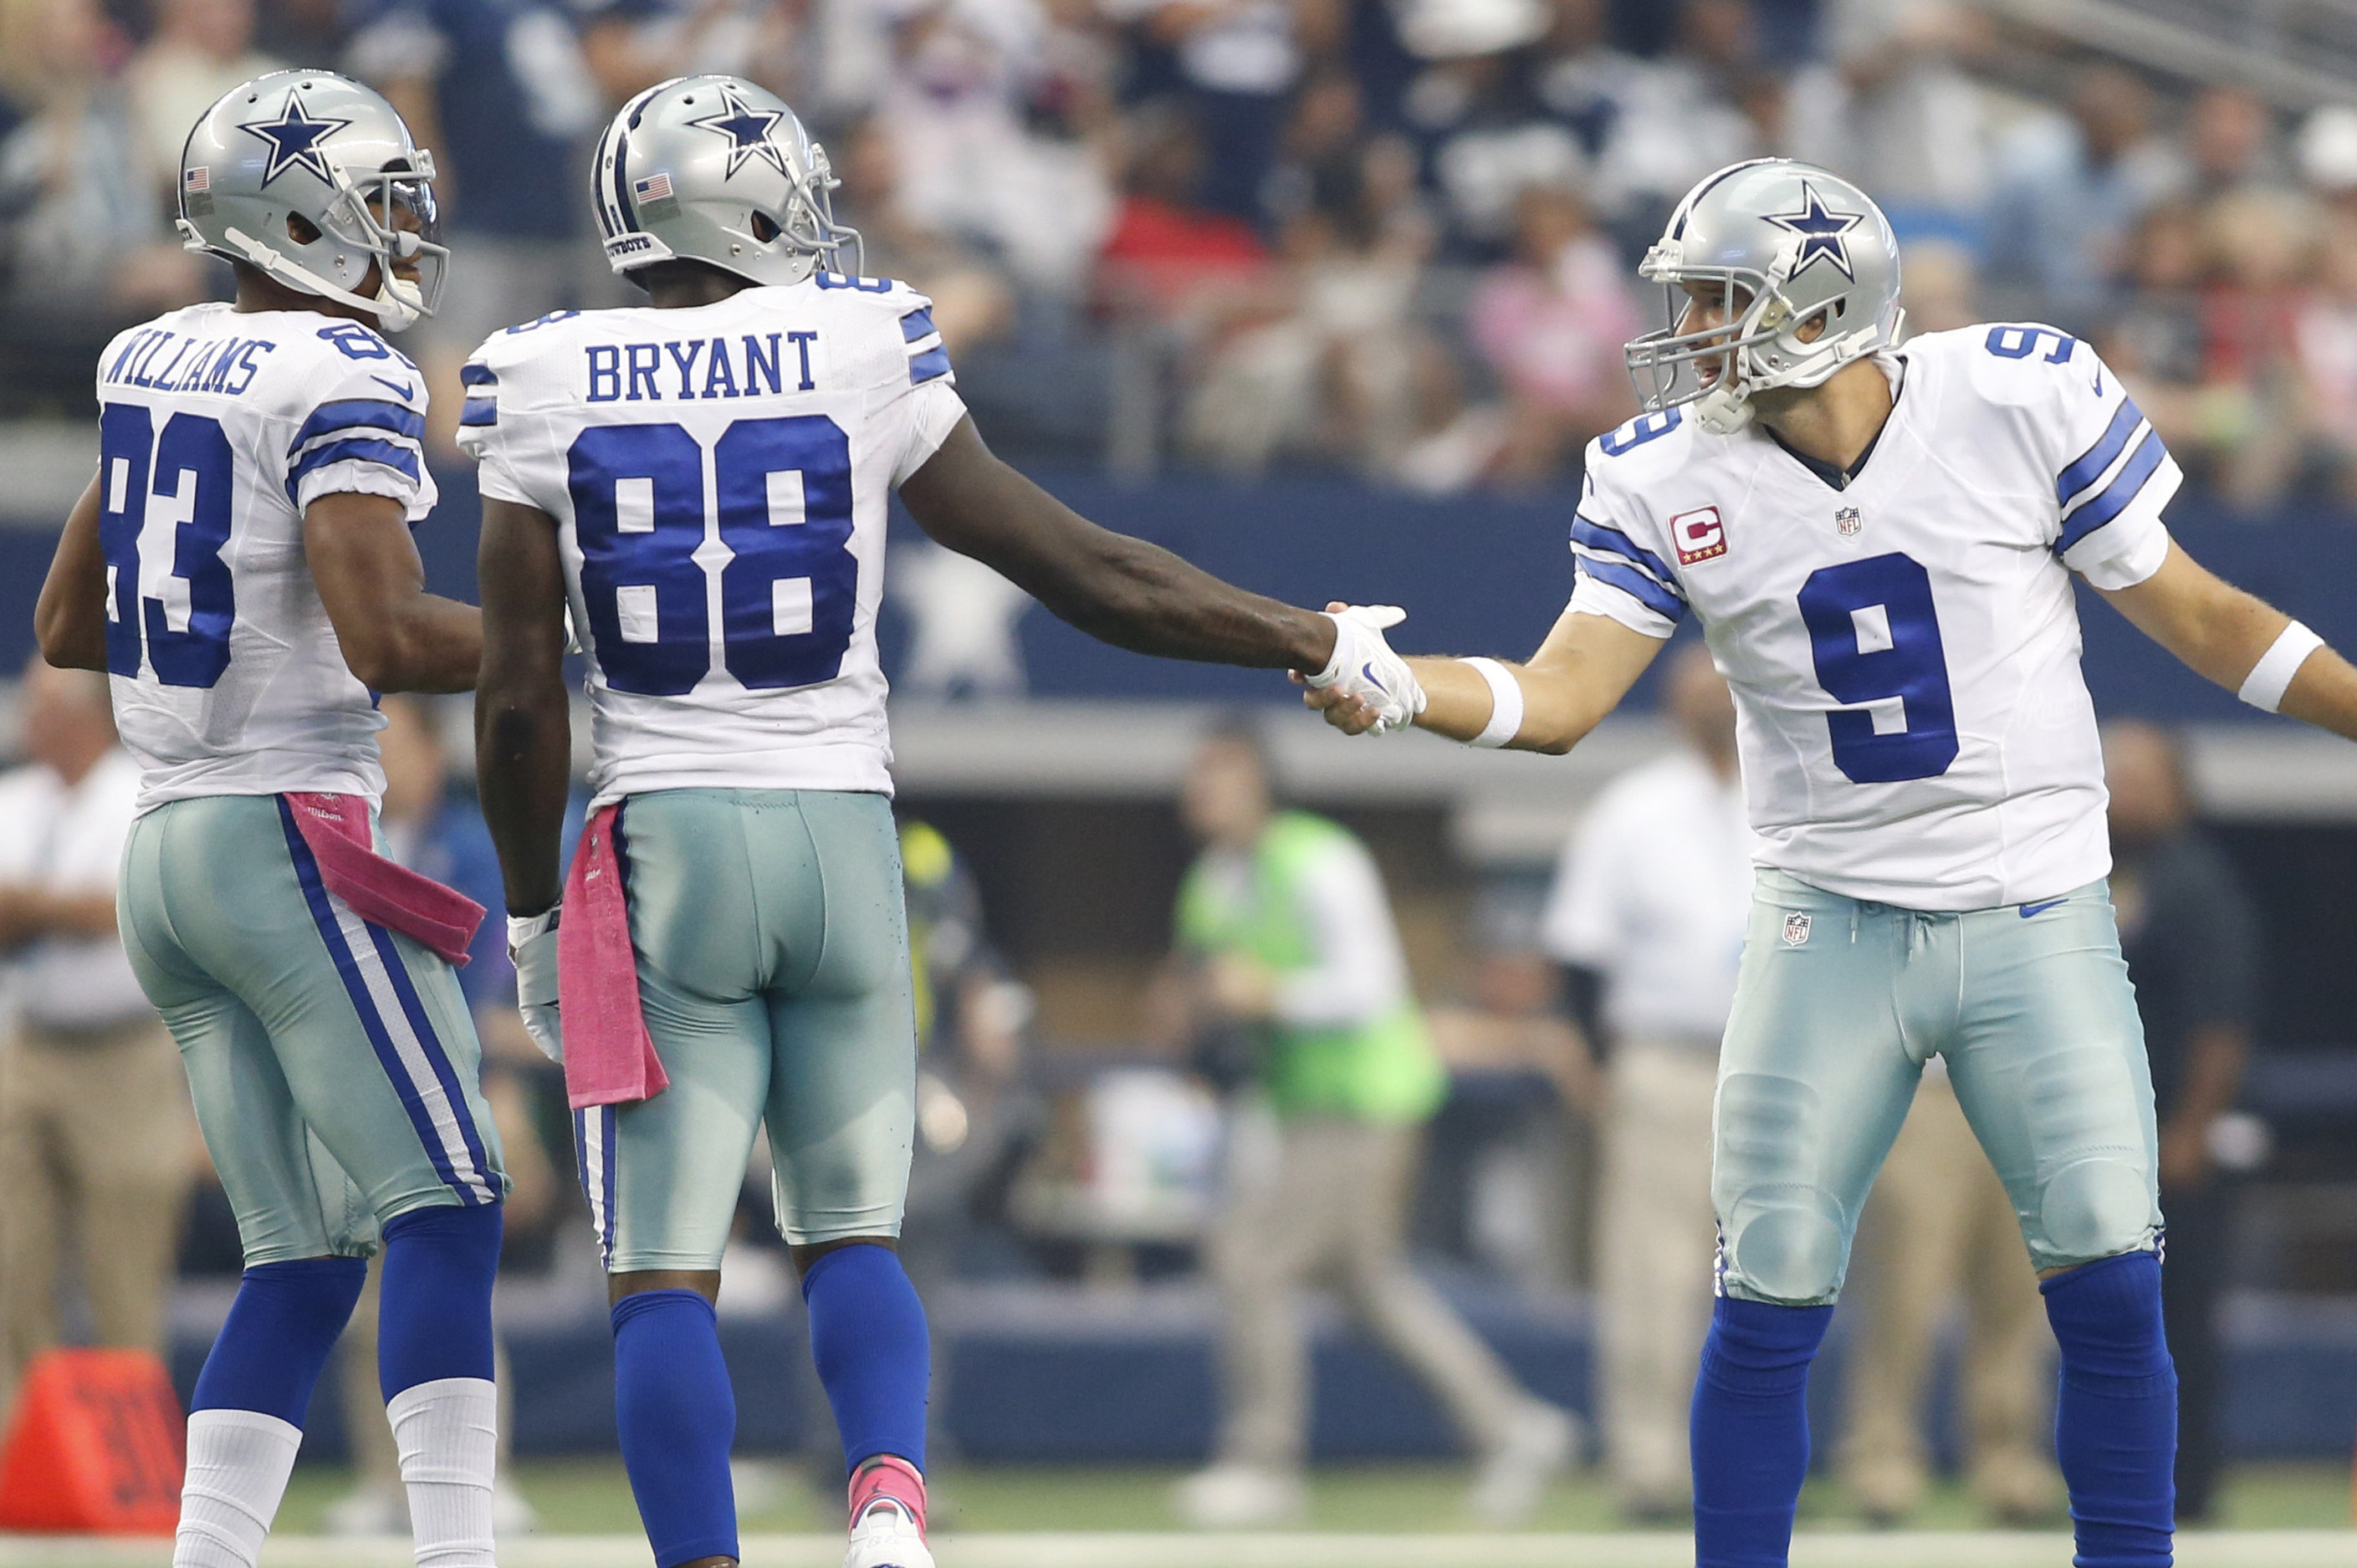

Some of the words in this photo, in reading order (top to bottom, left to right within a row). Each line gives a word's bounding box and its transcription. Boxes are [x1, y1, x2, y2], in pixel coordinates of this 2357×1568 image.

[585, 331, 818, 402] BRYANT
[1985, 326, 2076, 365] 9
[99, 401, 236, 688] 83
[1674, 508, 1722, 552] C
[1839, 518, 1859, 534] NFL
[566, 414, 858, 696] 88
[1797, 551, 1960, 784] 9
[1786, 926, 1805, 940] NFL
